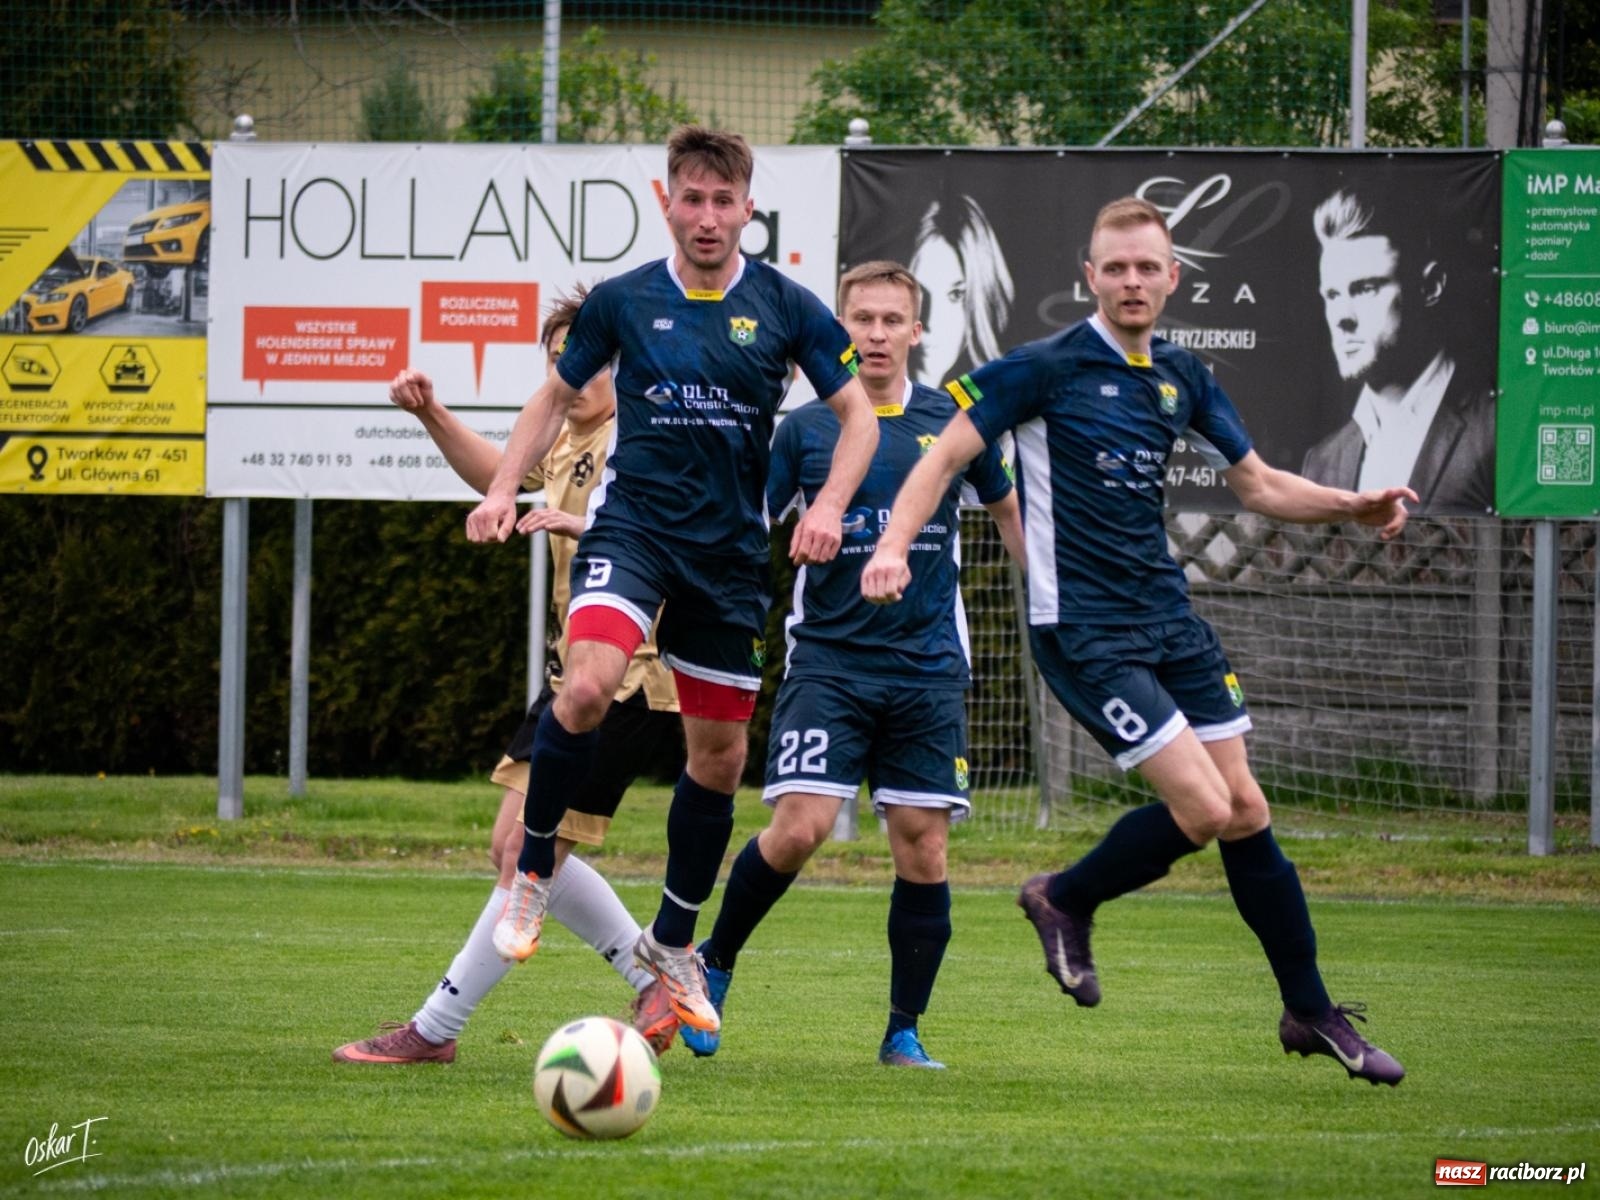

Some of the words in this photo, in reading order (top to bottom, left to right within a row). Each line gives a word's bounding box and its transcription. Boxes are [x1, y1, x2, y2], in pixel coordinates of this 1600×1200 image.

[1527, 174, 1568, 194] iMP
[244, 177, 639, 264] HOLLAND
[1531, 221, 1590, 233] automatyka
[1531, 236, 1572, 248] pomiary
[439, 297, 519, 310] ROZLICZENIA
[295, 321, 357, 333] WSZYSTKIE
[440, 313, 518, 326] PODATKOWE
[256, 336, 344, 350] HOLENDERSKIE
[346, 337, 396, 351] SPRAWY
[265, 353, 278, 365] W
[281, 353, 331, 366] JEDNYM
[333, 353, 386, 367] MIEJSCU
[1542, 363, 1594, 376] Tworków
[57, 447, 129, 462] Tworków
[133, 448, 151, 462] 47
[241, 453, 265, 466] +48
[269, 453, 285, 467] 32
[290, 454, 313, 467] 740
[317, 454, 332, 467] 91
[336, 454, 352, 467] 93
[369, 455, 394, 468] +48
[398, 455, 421, 468] 608
[81, 467, 140, 482] Główna
[145, 468, 160, 482] 61
[1166, 466, 1216, 487] 47-451
[585, 558, 612, 588] 9
[1102, 696, 1149, 743] 8
[777, 728, 829, 776] 22
